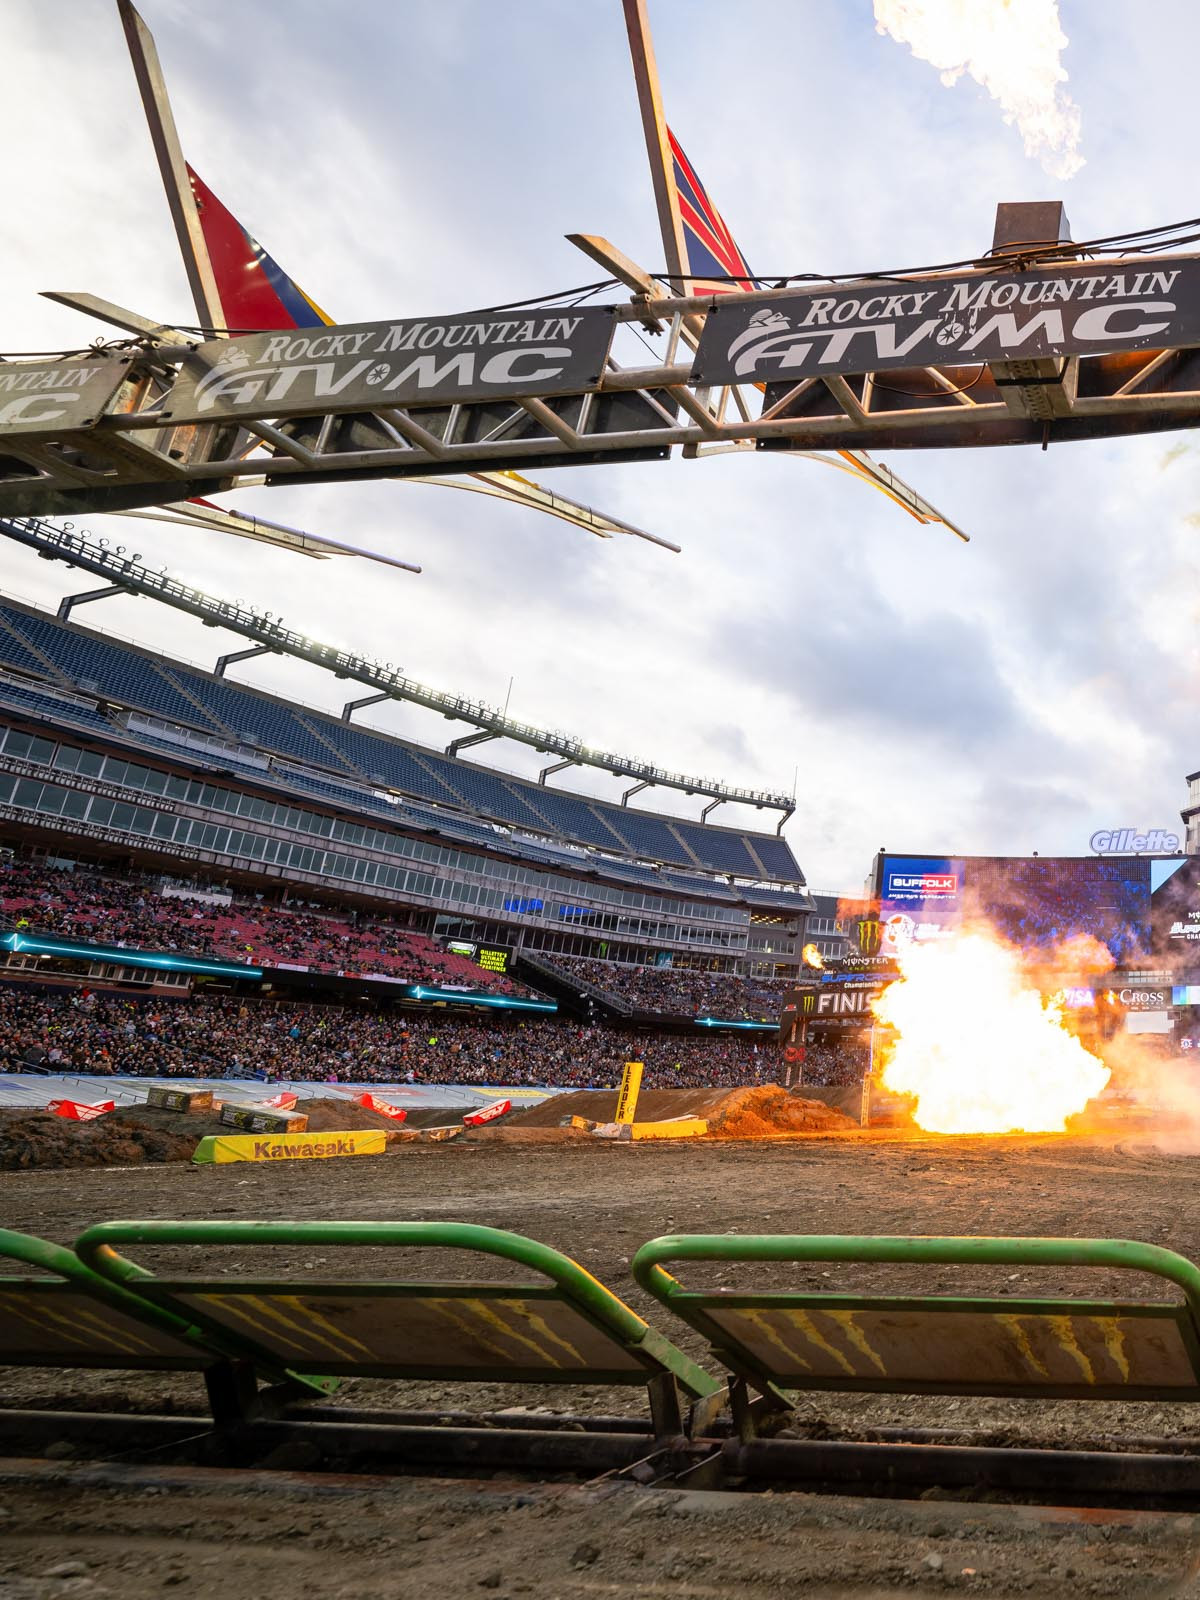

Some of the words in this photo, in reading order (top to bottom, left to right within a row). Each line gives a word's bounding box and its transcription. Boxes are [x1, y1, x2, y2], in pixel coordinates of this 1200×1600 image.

[797, 291, 938, 327] ROCKY
[938, 270, 1182, 312] MOUNTAIN
[256, 332, 376, 364] ROCKY
[373, 317, 584, 352] MOUNTAIN
[0, 368, 102, 392] NTAIN
[0, 393, 80, 425] C
[1090, 829, 1179, 852] Gillette
[893, 878, 953, 888] SUFFOLK
[842, 957, 888, 966] MONSTER
[1119, 989, 1164, 1004] CROSS
[618, 1065, 632, 1119] LEADER
[254, 1138, 356, 1160] Kawasaki
